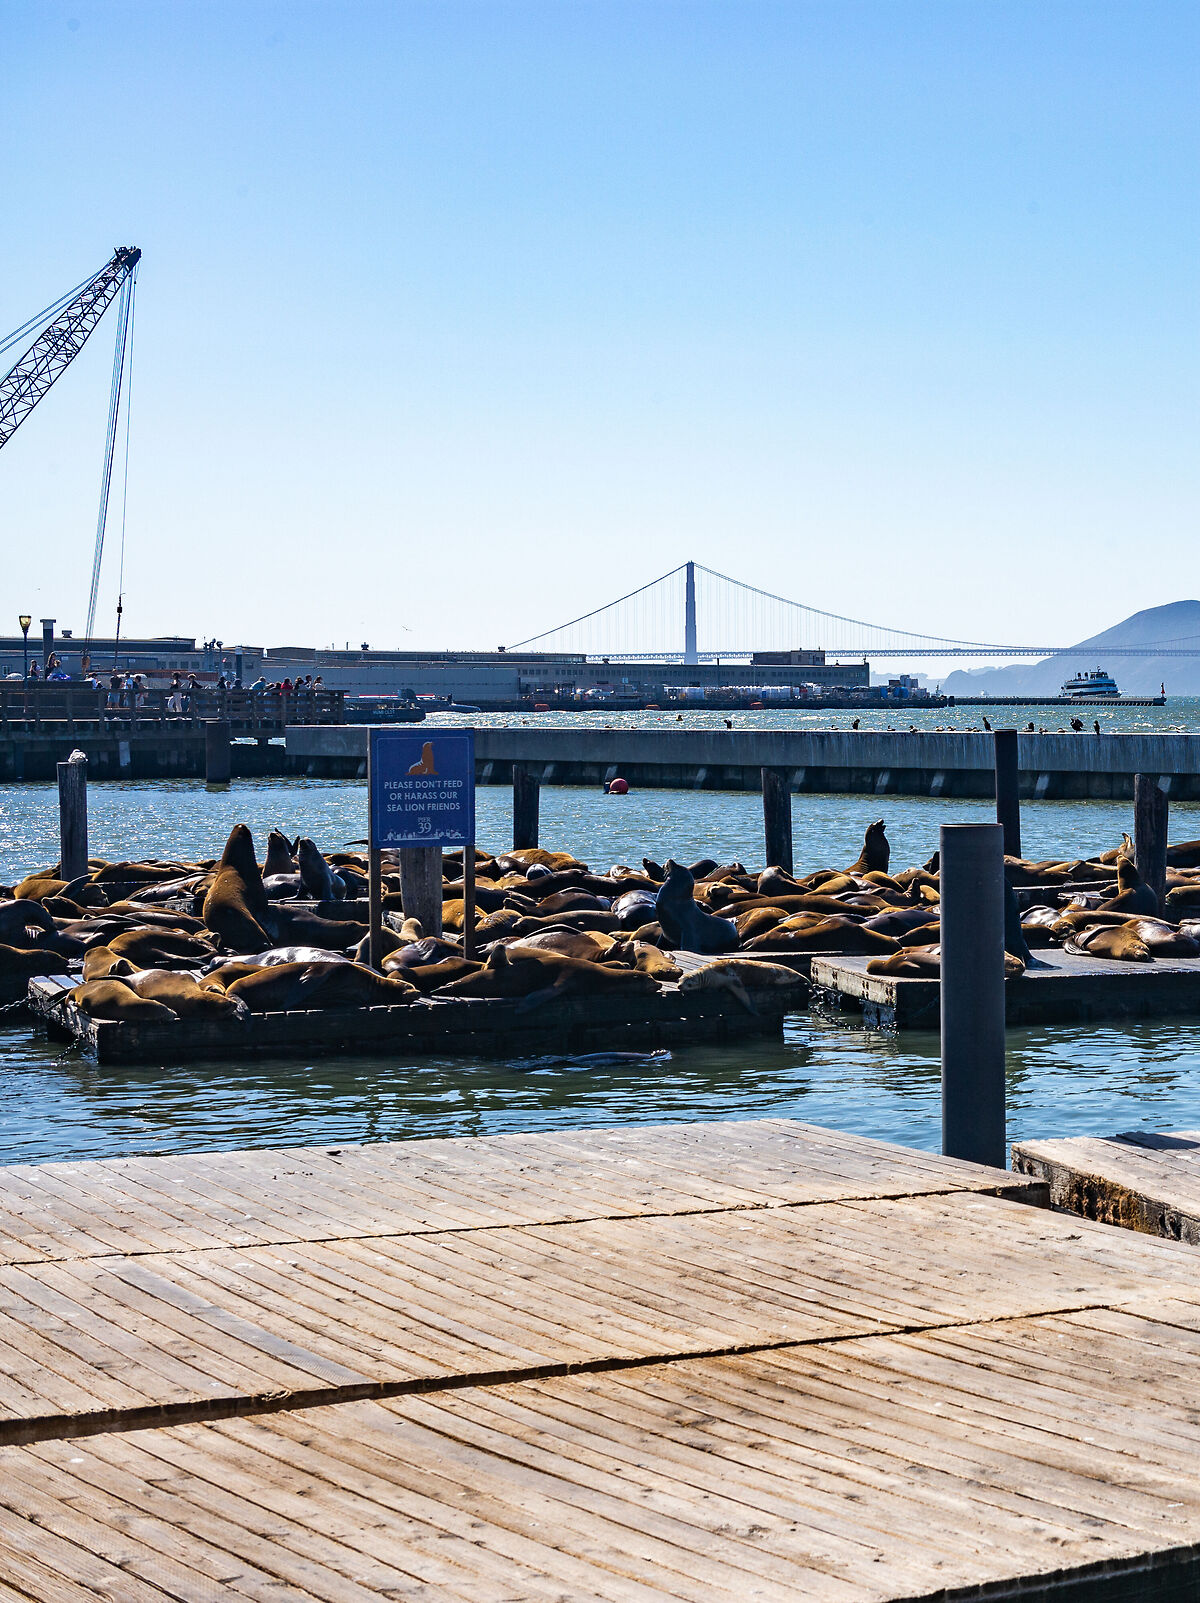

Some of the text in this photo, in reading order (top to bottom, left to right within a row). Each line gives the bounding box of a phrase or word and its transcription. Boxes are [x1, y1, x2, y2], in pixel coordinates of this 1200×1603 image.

[384, 780, 463, 789] PLEASE DON'T FEED
[389, 791, 458, 800] OR HARASS OUR
[386, 802, 461, 812] SEA LION FRIENDS
[417, 822, 432, 834] 39
